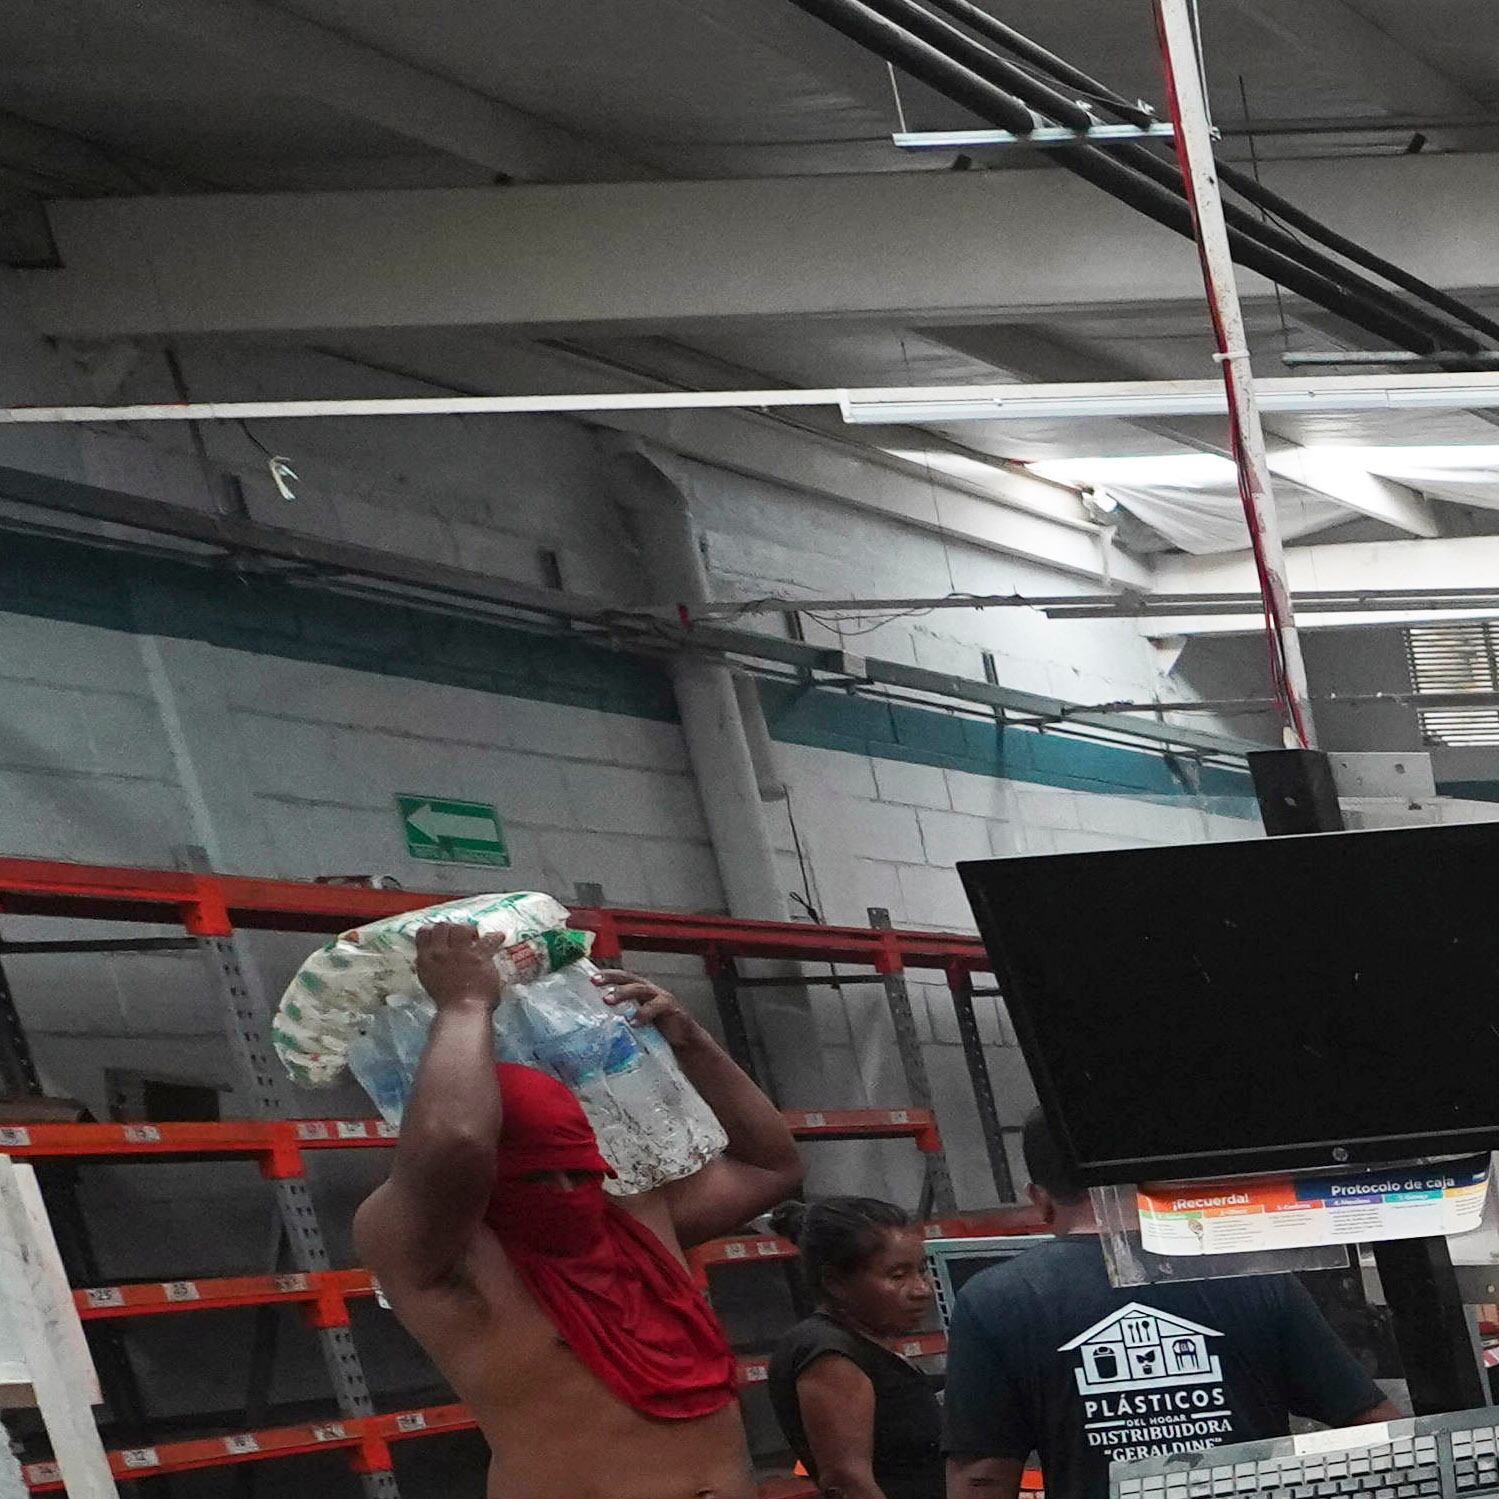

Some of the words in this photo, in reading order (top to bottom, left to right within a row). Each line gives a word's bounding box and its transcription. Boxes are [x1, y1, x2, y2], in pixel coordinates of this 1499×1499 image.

[1331, 1180, 1401, 1196] Protocolo
[1404, 1178, 1422, 1190] de
[1426, 1176, 1456, 1190] caja
[1084, 1388, 1226, 1419] PLÁSTICOS
[1087, 1418, 1233, 1447] DISTRIBUIDORA
[1126, 1417, 1146, 1428] DEL
[1149, 1413, 1188, 1426] HOGAR
